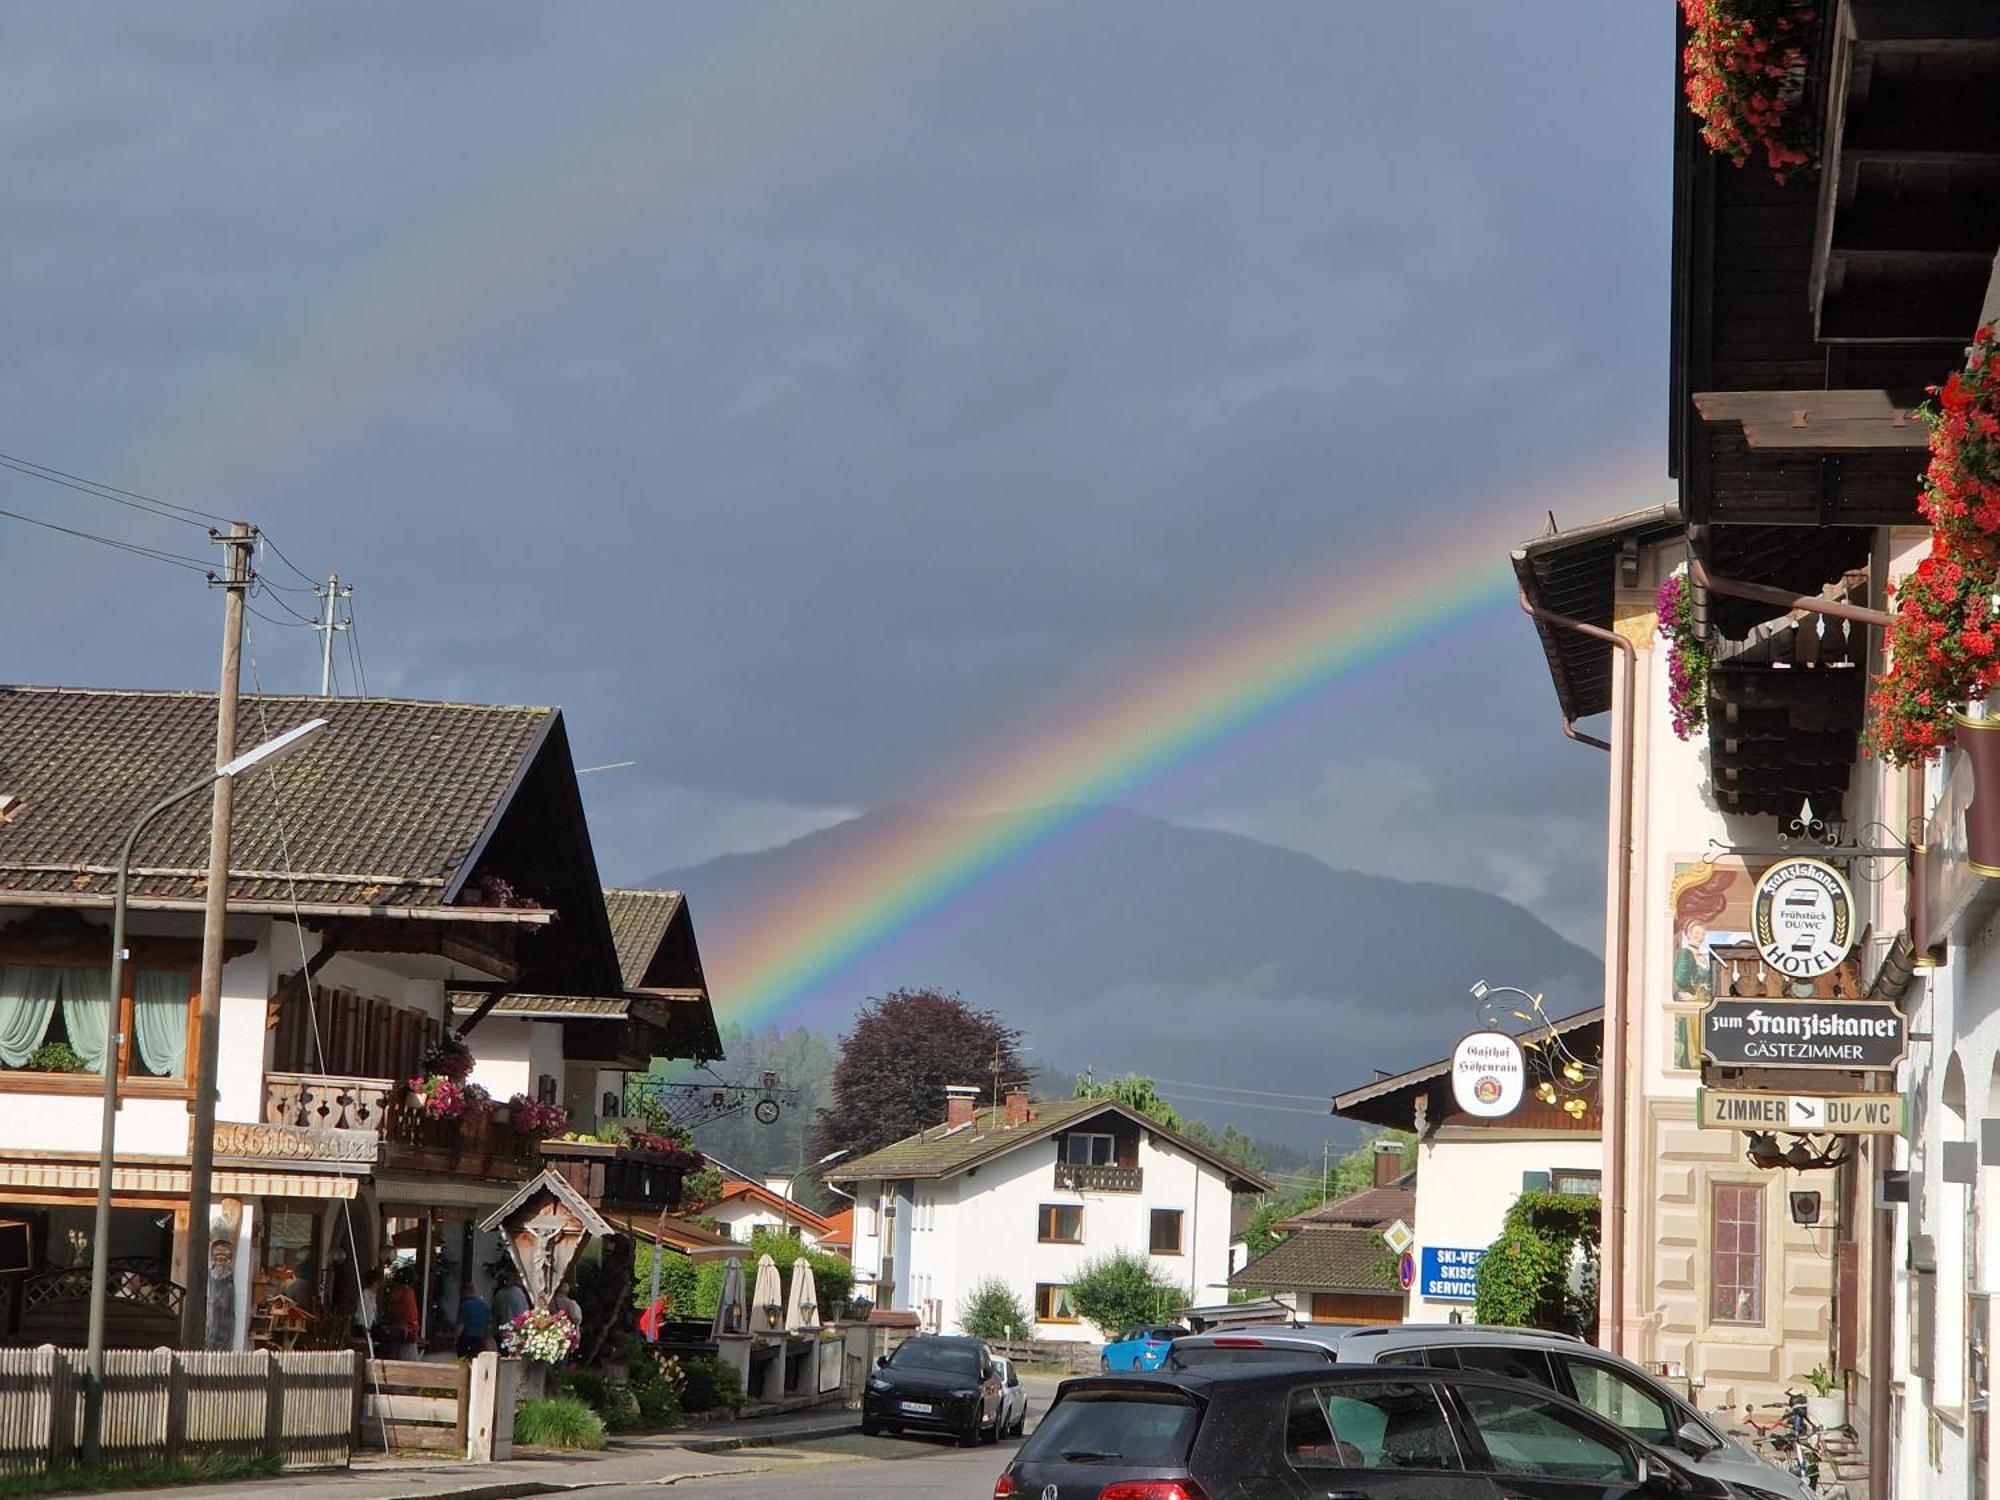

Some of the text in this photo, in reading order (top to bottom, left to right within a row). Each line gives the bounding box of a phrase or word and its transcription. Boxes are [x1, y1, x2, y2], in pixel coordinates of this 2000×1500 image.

[1763, 864, 1842, 895] Franziskaner
[1780, 910, 1826, 920] Frühstück
[1785, 921, 1823, 930] DU/WC
[1767, 946, 1839, 974] HOTEL
[1712, 1009, 1897, 1040] zum Franziskaner
[1467, 1046, 1511, 1059] Gasthof
[1744, 1040, 1864, 1059] GÄSTEZIMMER
[1459, 1060, 1518, 1073] Höhenrain
[1716, 1099, 1891, 1125] ZIMMER DU/WC
[1440, 1265, 1477, 1280] SKISC
